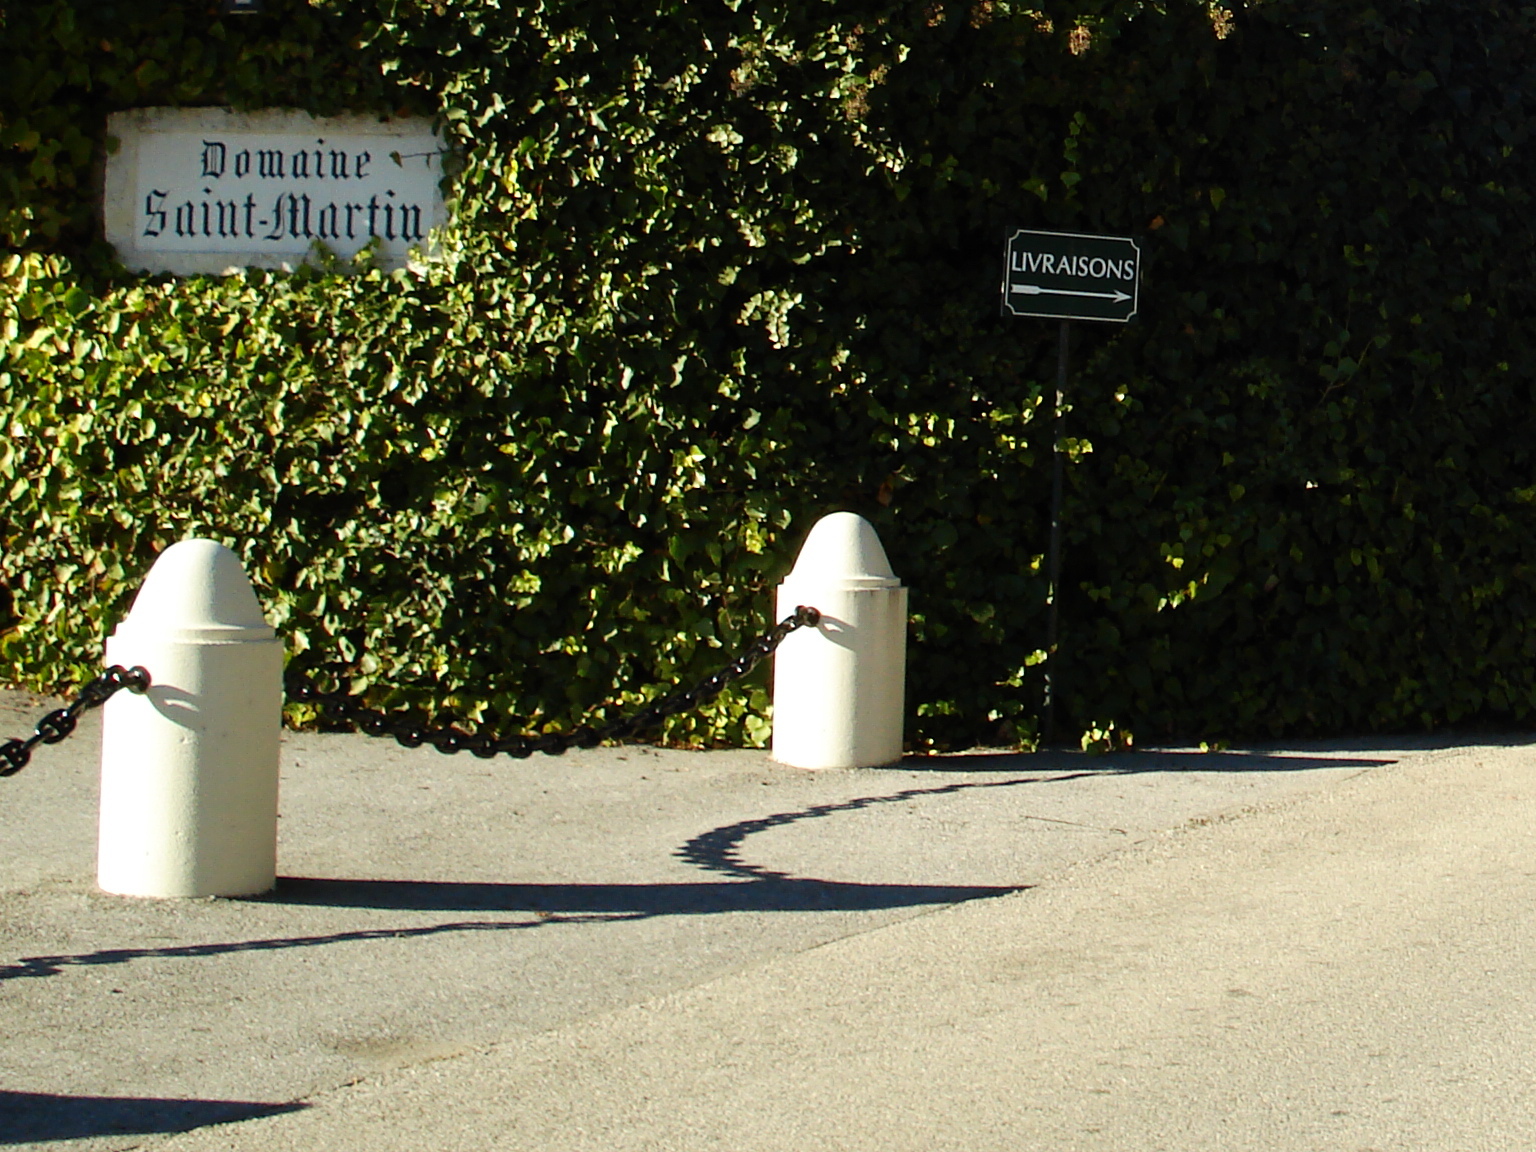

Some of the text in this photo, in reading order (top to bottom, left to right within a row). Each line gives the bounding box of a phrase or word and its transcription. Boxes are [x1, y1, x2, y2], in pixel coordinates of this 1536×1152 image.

[200, 138, 371, 179] Domaine
[143, 187, 425, 242] Saint-Martin
[1011, 250, 1135, 281] LIVRAISONS
